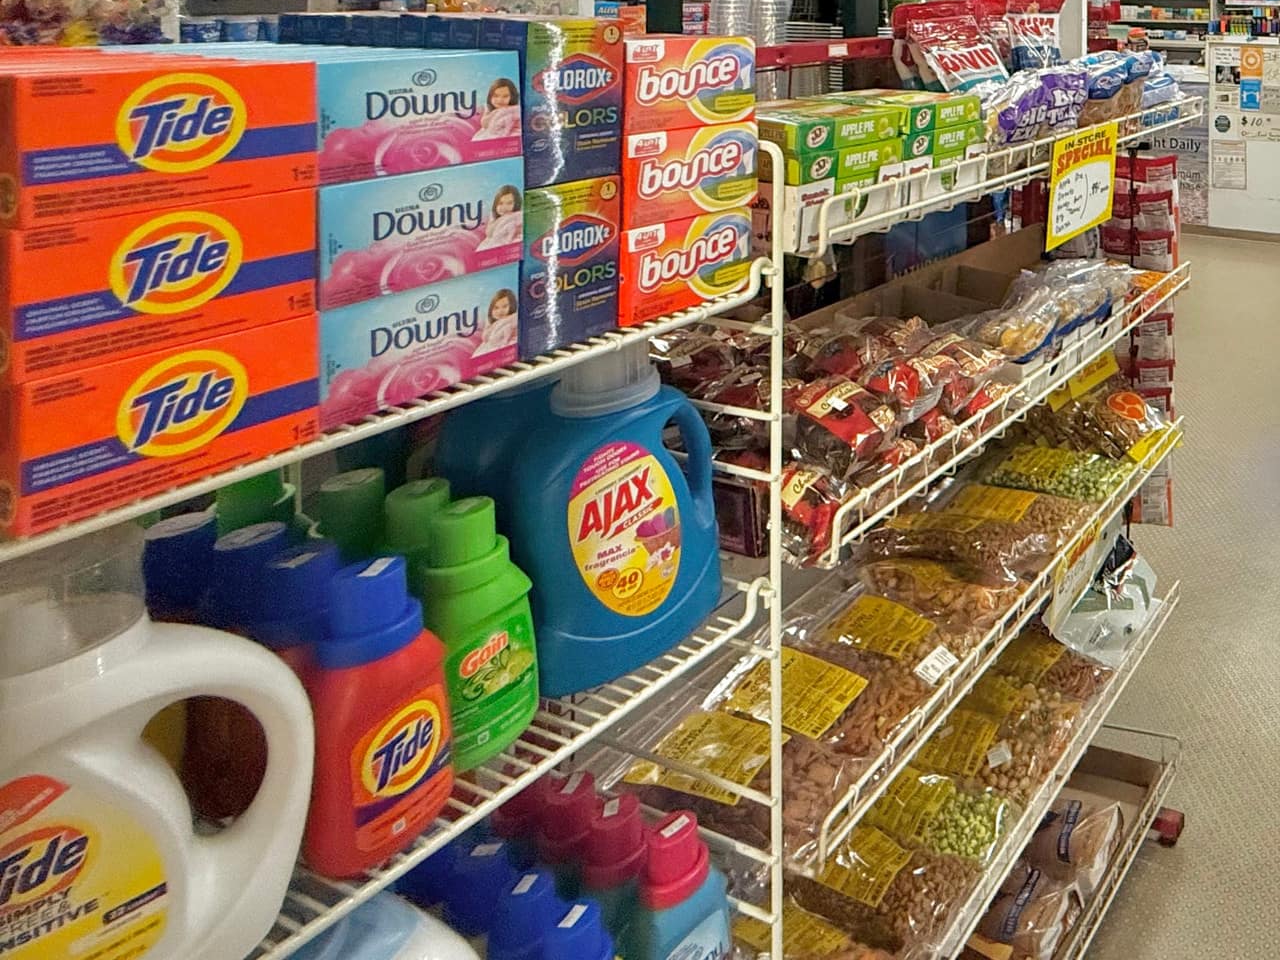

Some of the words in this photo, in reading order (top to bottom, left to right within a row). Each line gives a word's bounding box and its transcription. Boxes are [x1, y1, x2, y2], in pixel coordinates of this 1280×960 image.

[640, 56, 739, 101] bounce
[129, 96, 235, 161] Tide
[366, 90, 478, 120] Downy
[530, 106, 617, 133] CLORS
[642, 143, 742, 195] bounce
[1056, 136, 1113, 177] SPECIAL
[1169, 137, 1202, 153] Daily
[372, 199, 483, 241] Downy
[123, 232, 231, 308] Tide
[642, 228, 737, 291] bounce
[370, 305, 479, 358] Downy
[128, 369, 236, 454] Tide
[577, 465, 654, 544] AJAX
[596, 543, 625, 560] MAX
[460, 631, 509, 678] Gain
[371, 715, 435, 795] Tide
[0, 898, 99, 953] NSITIVE
